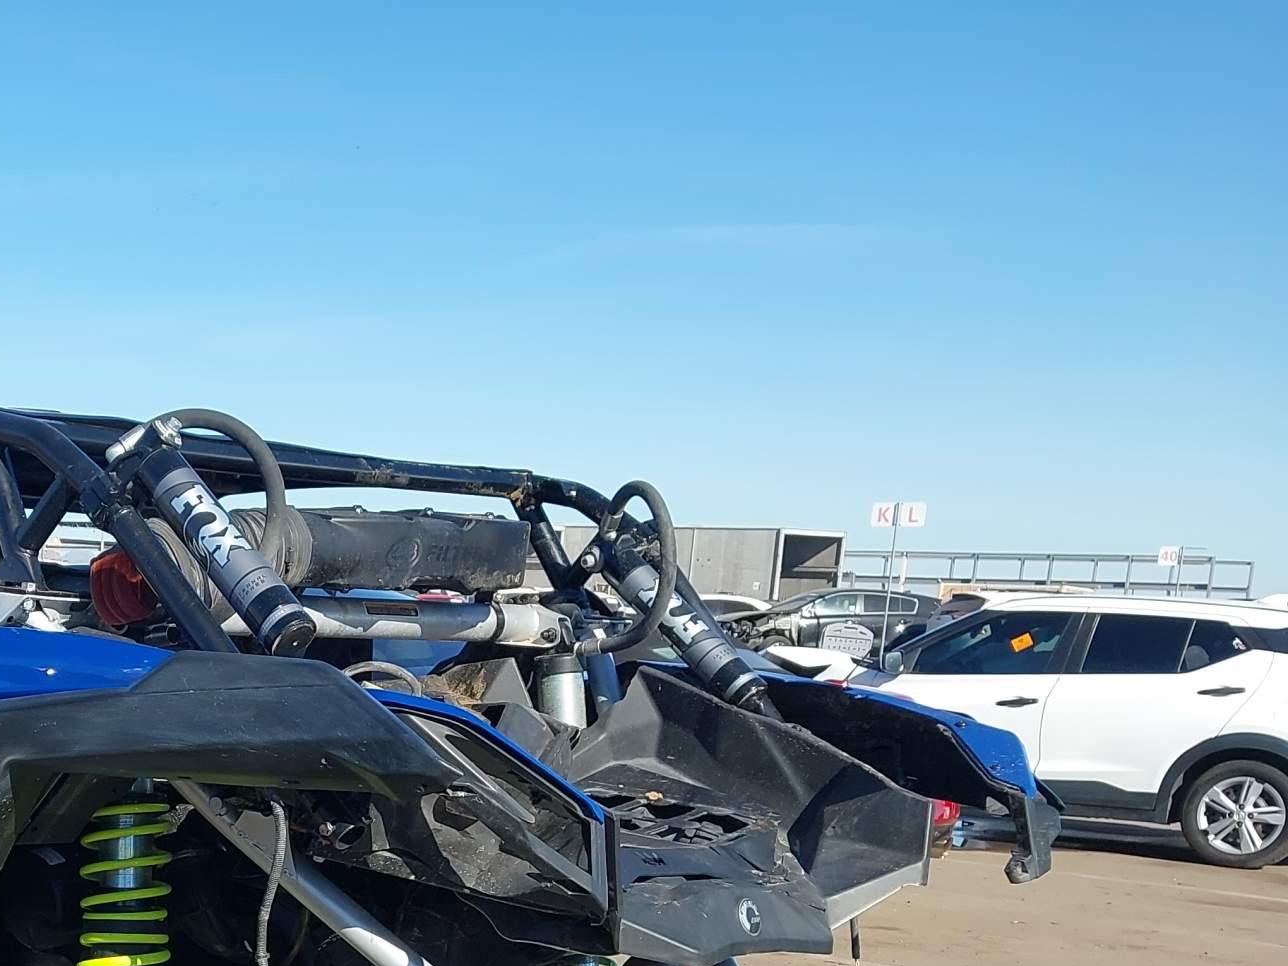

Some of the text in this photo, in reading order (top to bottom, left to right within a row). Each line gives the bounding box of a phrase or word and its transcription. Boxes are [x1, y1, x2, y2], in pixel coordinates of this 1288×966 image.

[878, 507, 889, 522] K
[908, 506, 919, 522] L
[171, 484, 252, 568] FOX
[1160, 551, 1177, 561] 40
